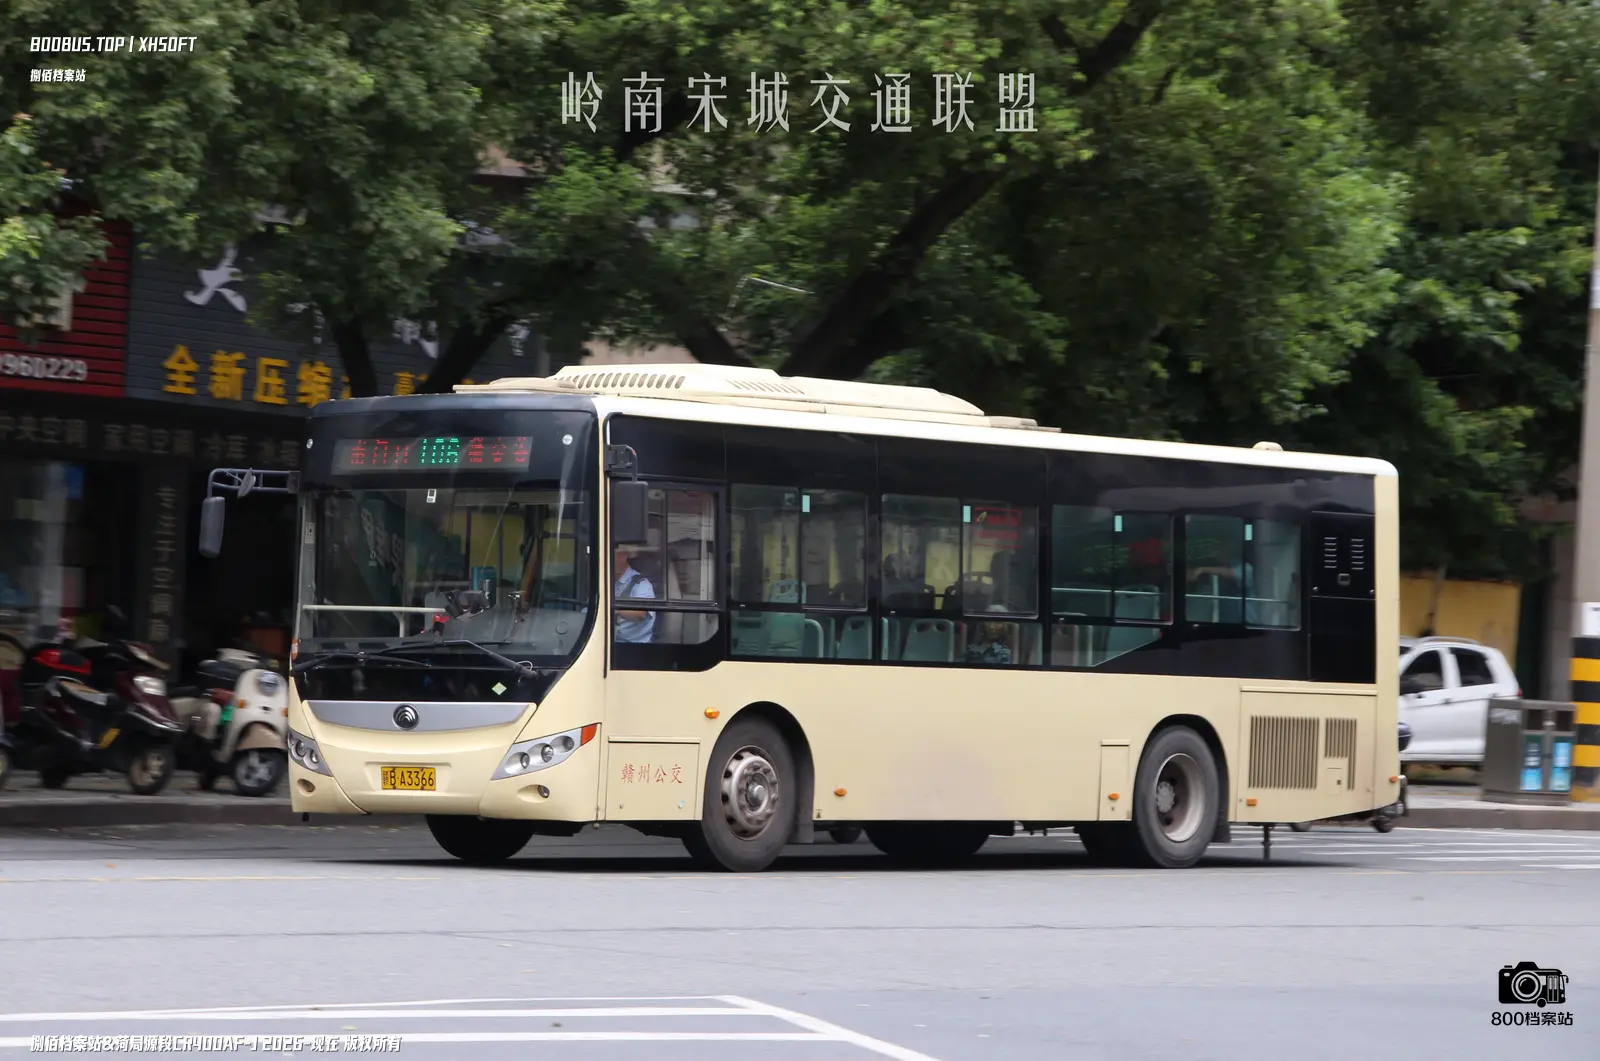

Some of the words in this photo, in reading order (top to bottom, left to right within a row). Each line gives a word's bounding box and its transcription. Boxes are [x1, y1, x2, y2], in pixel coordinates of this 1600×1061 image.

[0, 344, 88, 381] 960229
[621, 763, 683, 784] 赣州公交
